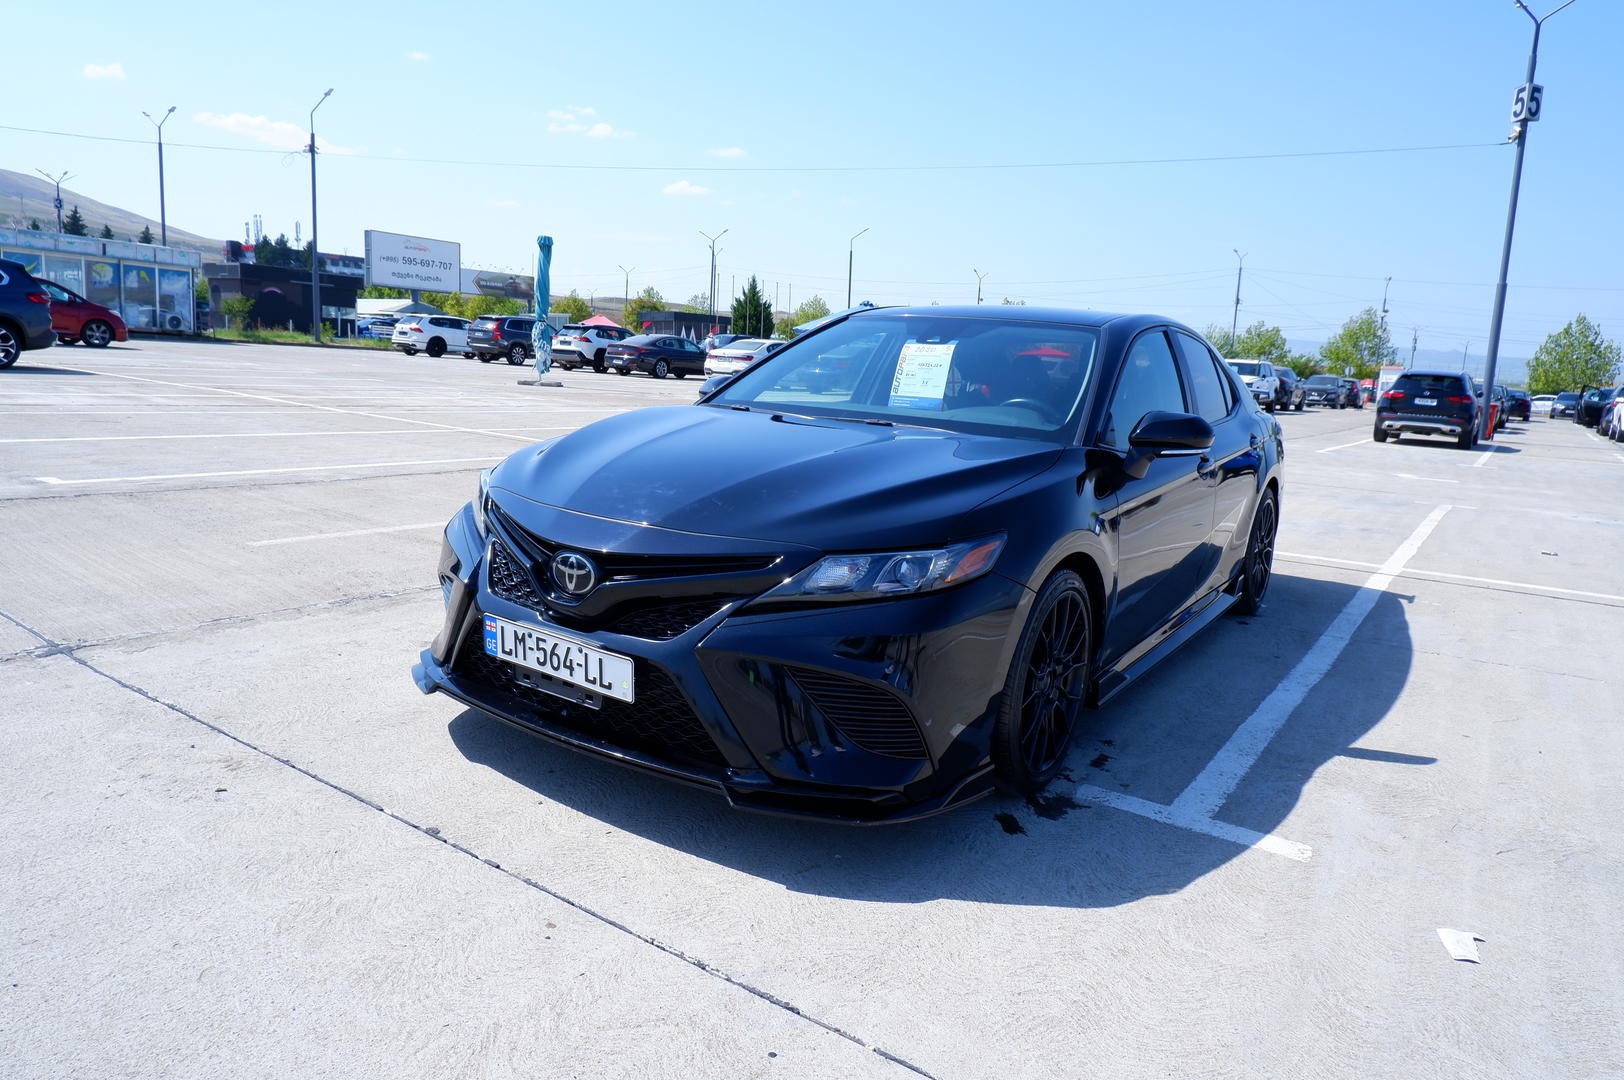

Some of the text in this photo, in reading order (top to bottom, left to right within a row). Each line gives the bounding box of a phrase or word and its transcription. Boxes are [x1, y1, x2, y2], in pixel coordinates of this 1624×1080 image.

[402, 256, 453, 271] 595-697-707
[486, 637, 497, 652] GE
[500, 625, 612, 690] LM-564-LL
